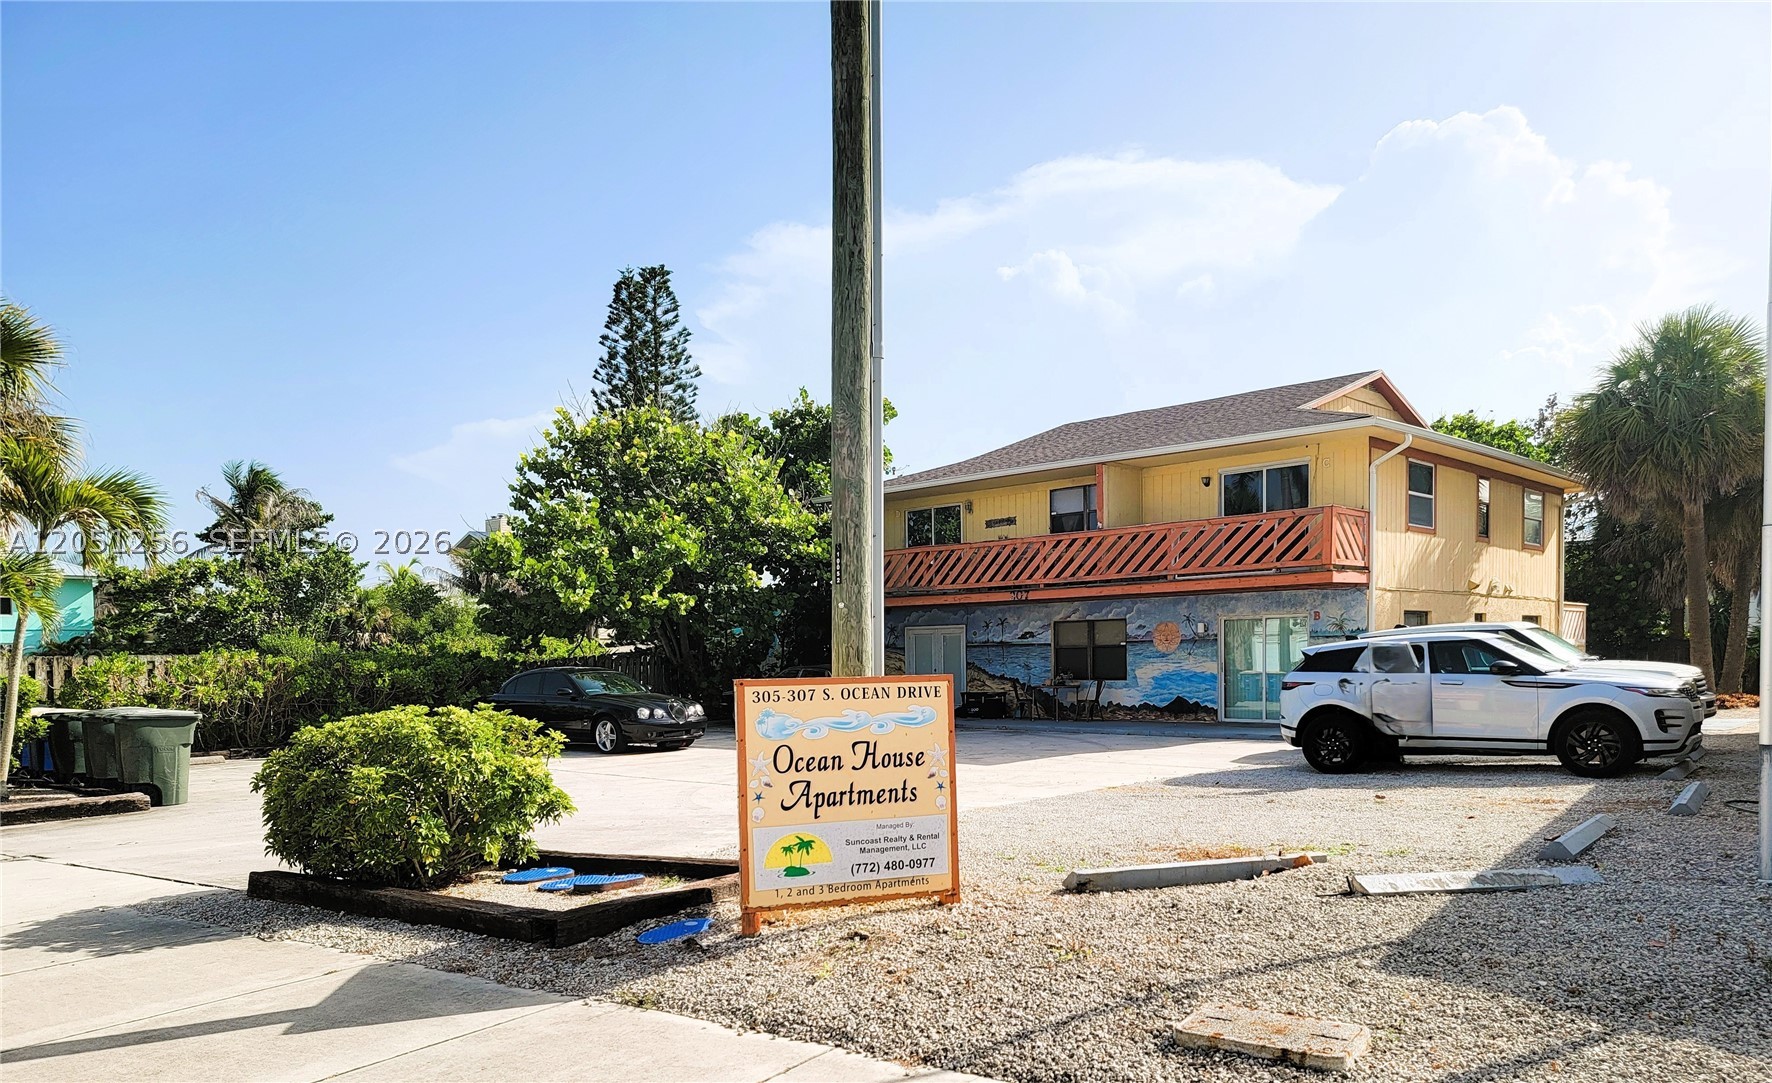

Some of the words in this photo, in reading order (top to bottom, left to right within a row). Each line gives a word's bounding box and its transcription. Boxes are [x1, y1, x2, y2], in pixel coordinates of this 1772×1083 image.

[1313, 610, 1321, 621] B
[752, 688, 816, 704] 305-307
[822, 688, 835, 701] S.
[840, 686, 891, 701] OCEAN
[897, 685, 942, 699] DRIVE
[772, 744, 844, 774] Ocean
[851, 740, 925, 772] House
[780, 778, 917, 820] Apartments
[876, 822, 903, 831] Managed
[905, 821, 915, 829] By:
[845, 836, 882, 846] Suncoast
[883, 834, 908, 845] Realty
[909, 833, 915, 842] &
[916, 832, 940, 841] Rental
[859, 844, 910, 855] Management,
[911, 842, 927, 851] LLC
[850, 861, 881, 877] (772)
[883, 857, 936, 872] 480-0977
[775, 888, 784, 899] 1,
[786, 887, 793, 897] 2
[796, 885, 815, 896] and
[818, 885, 824, 895] 3
[828, 881, 872, 894] Bedroom
[875, 877, 930, 892] Apartments
